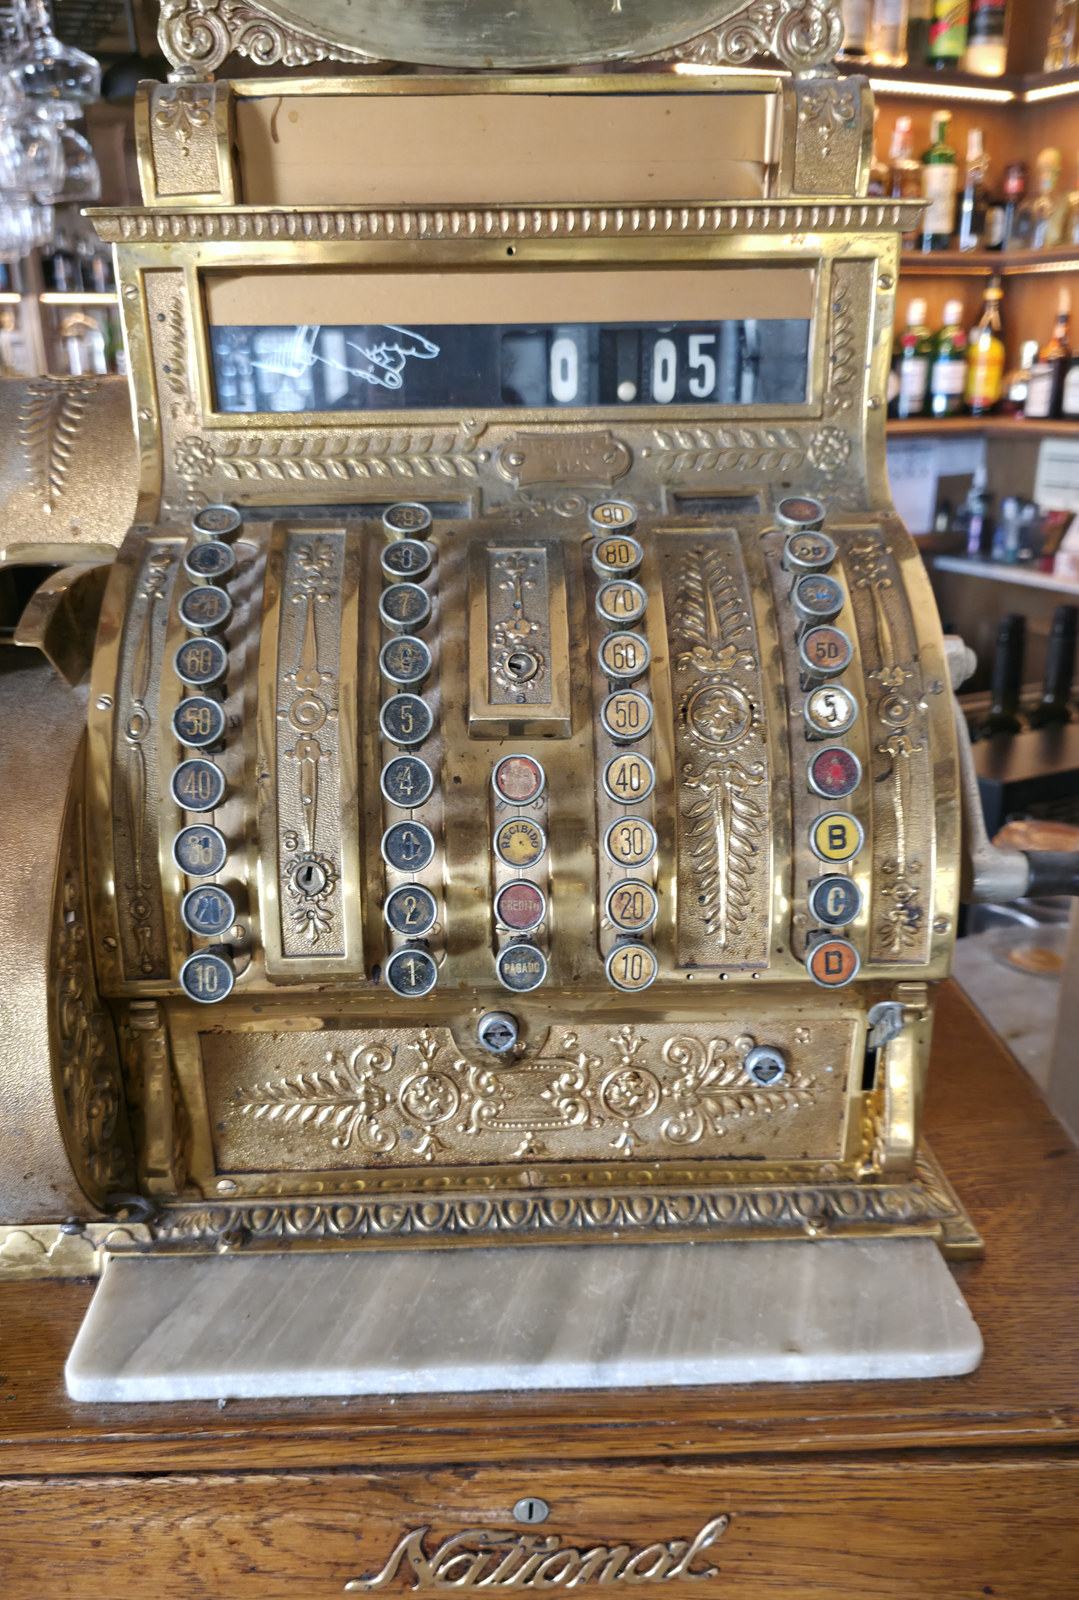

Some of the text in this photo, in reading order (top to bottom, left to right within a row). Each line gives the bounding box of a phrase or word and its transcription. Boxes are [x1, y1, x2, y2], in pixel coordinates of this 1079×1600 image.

[602, 507, 625, 523] 90
[606, 544, 629, 564] 80
[610, 589, 634, 612] 70
[186, 648, 212, 675] 60
[614, 643, 636, 668] 60
[185, 707, 211, 735] 50
[400, 705, 413, 733] 5
[616, 703, 639, 728] 50
[183, 770, 210, 800] 40
[400, 766, 413, 795] 4
[616, 763, 639, 791] 40
[501, 824, 540, 850] RECIBIDO
[620, 827, 643, 856] 30
[829, 825, 846, 851] B
[404, 897, 417, 925] 2
[621, 890, 644, 920] 20
[827, 887, 844, 915] C
[404, 959, 416, 986] 1
[504, 960, 540, 974] PAGADO
[622, 953, 643, 980] 10
[826, 951, 843, 974] D
[195, 965, 217, 992] 10
[344, 1513, 731, 1591] National
